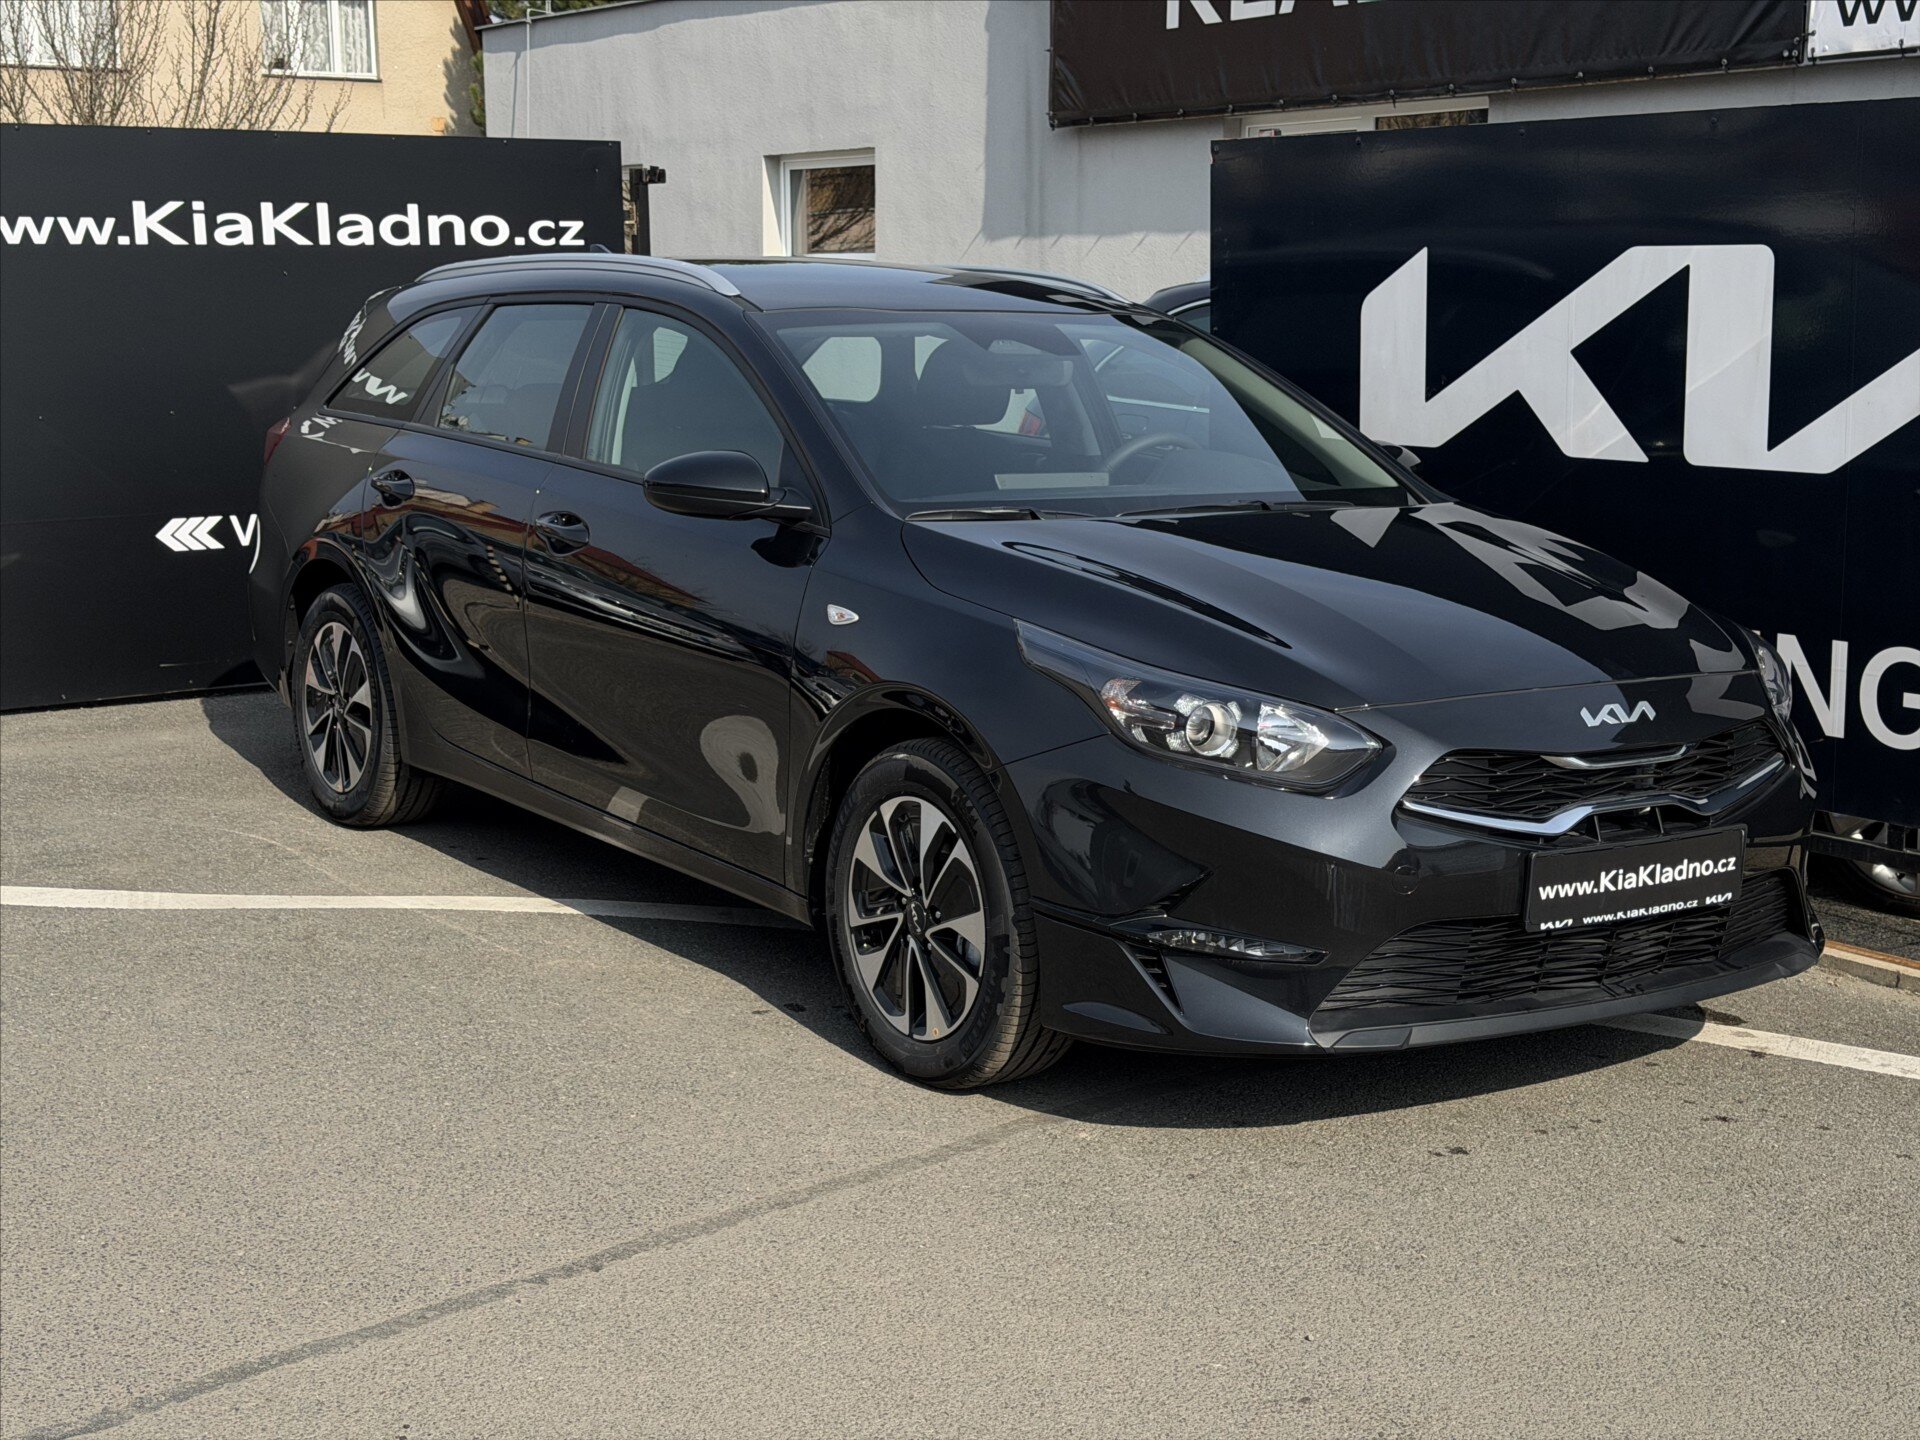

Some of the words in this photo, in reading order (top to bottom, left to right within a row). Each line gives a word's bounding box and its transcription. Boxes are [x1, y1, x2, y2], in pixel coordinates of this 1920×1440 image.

[0, 200, 585, 247] ww.KiaKladno.cz
[1752, 630, 1920, 751] NG
[1580, 700, 1656, 728] KIA
[1538, 856, 1737, 901] www.KiaKladno.cz
